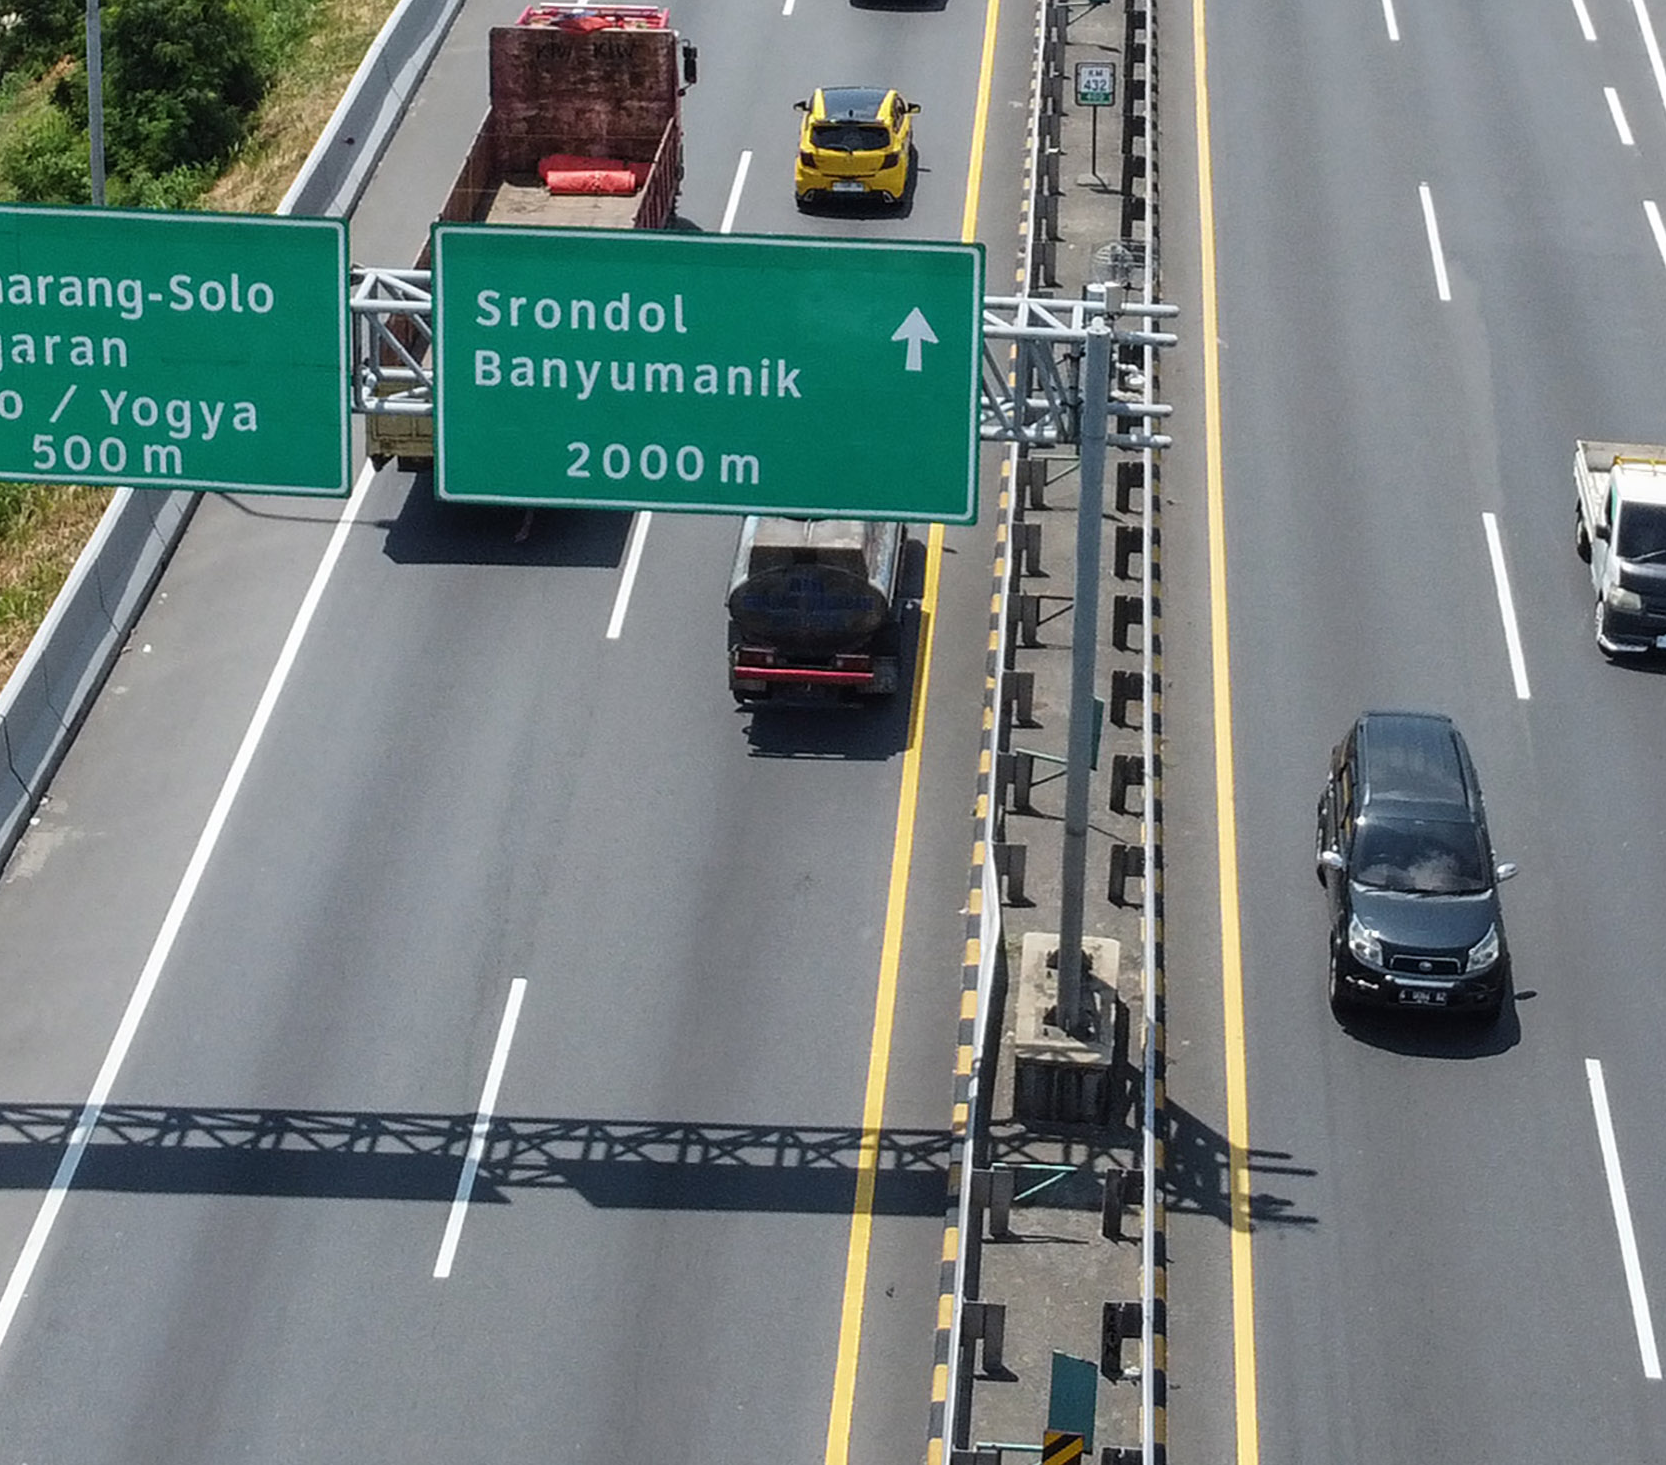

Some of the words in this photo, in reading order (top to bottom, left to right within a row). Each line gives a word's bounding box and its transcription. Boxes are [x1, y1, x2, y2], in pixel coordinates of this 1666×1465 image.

[1083, 79, 1108, 92] 432
[475, 290, 688, 333] Srondol
[474, 350, 802, 401] Banyumanik
[50, 385, 76, 423] /
[100, 390, 258, 440] Yogya
[33, 433, 127, 473] 500
[144, 444, 183, 475] m
[566, 442, 704, 482] 2000
[720, 454, 760, 485] m
